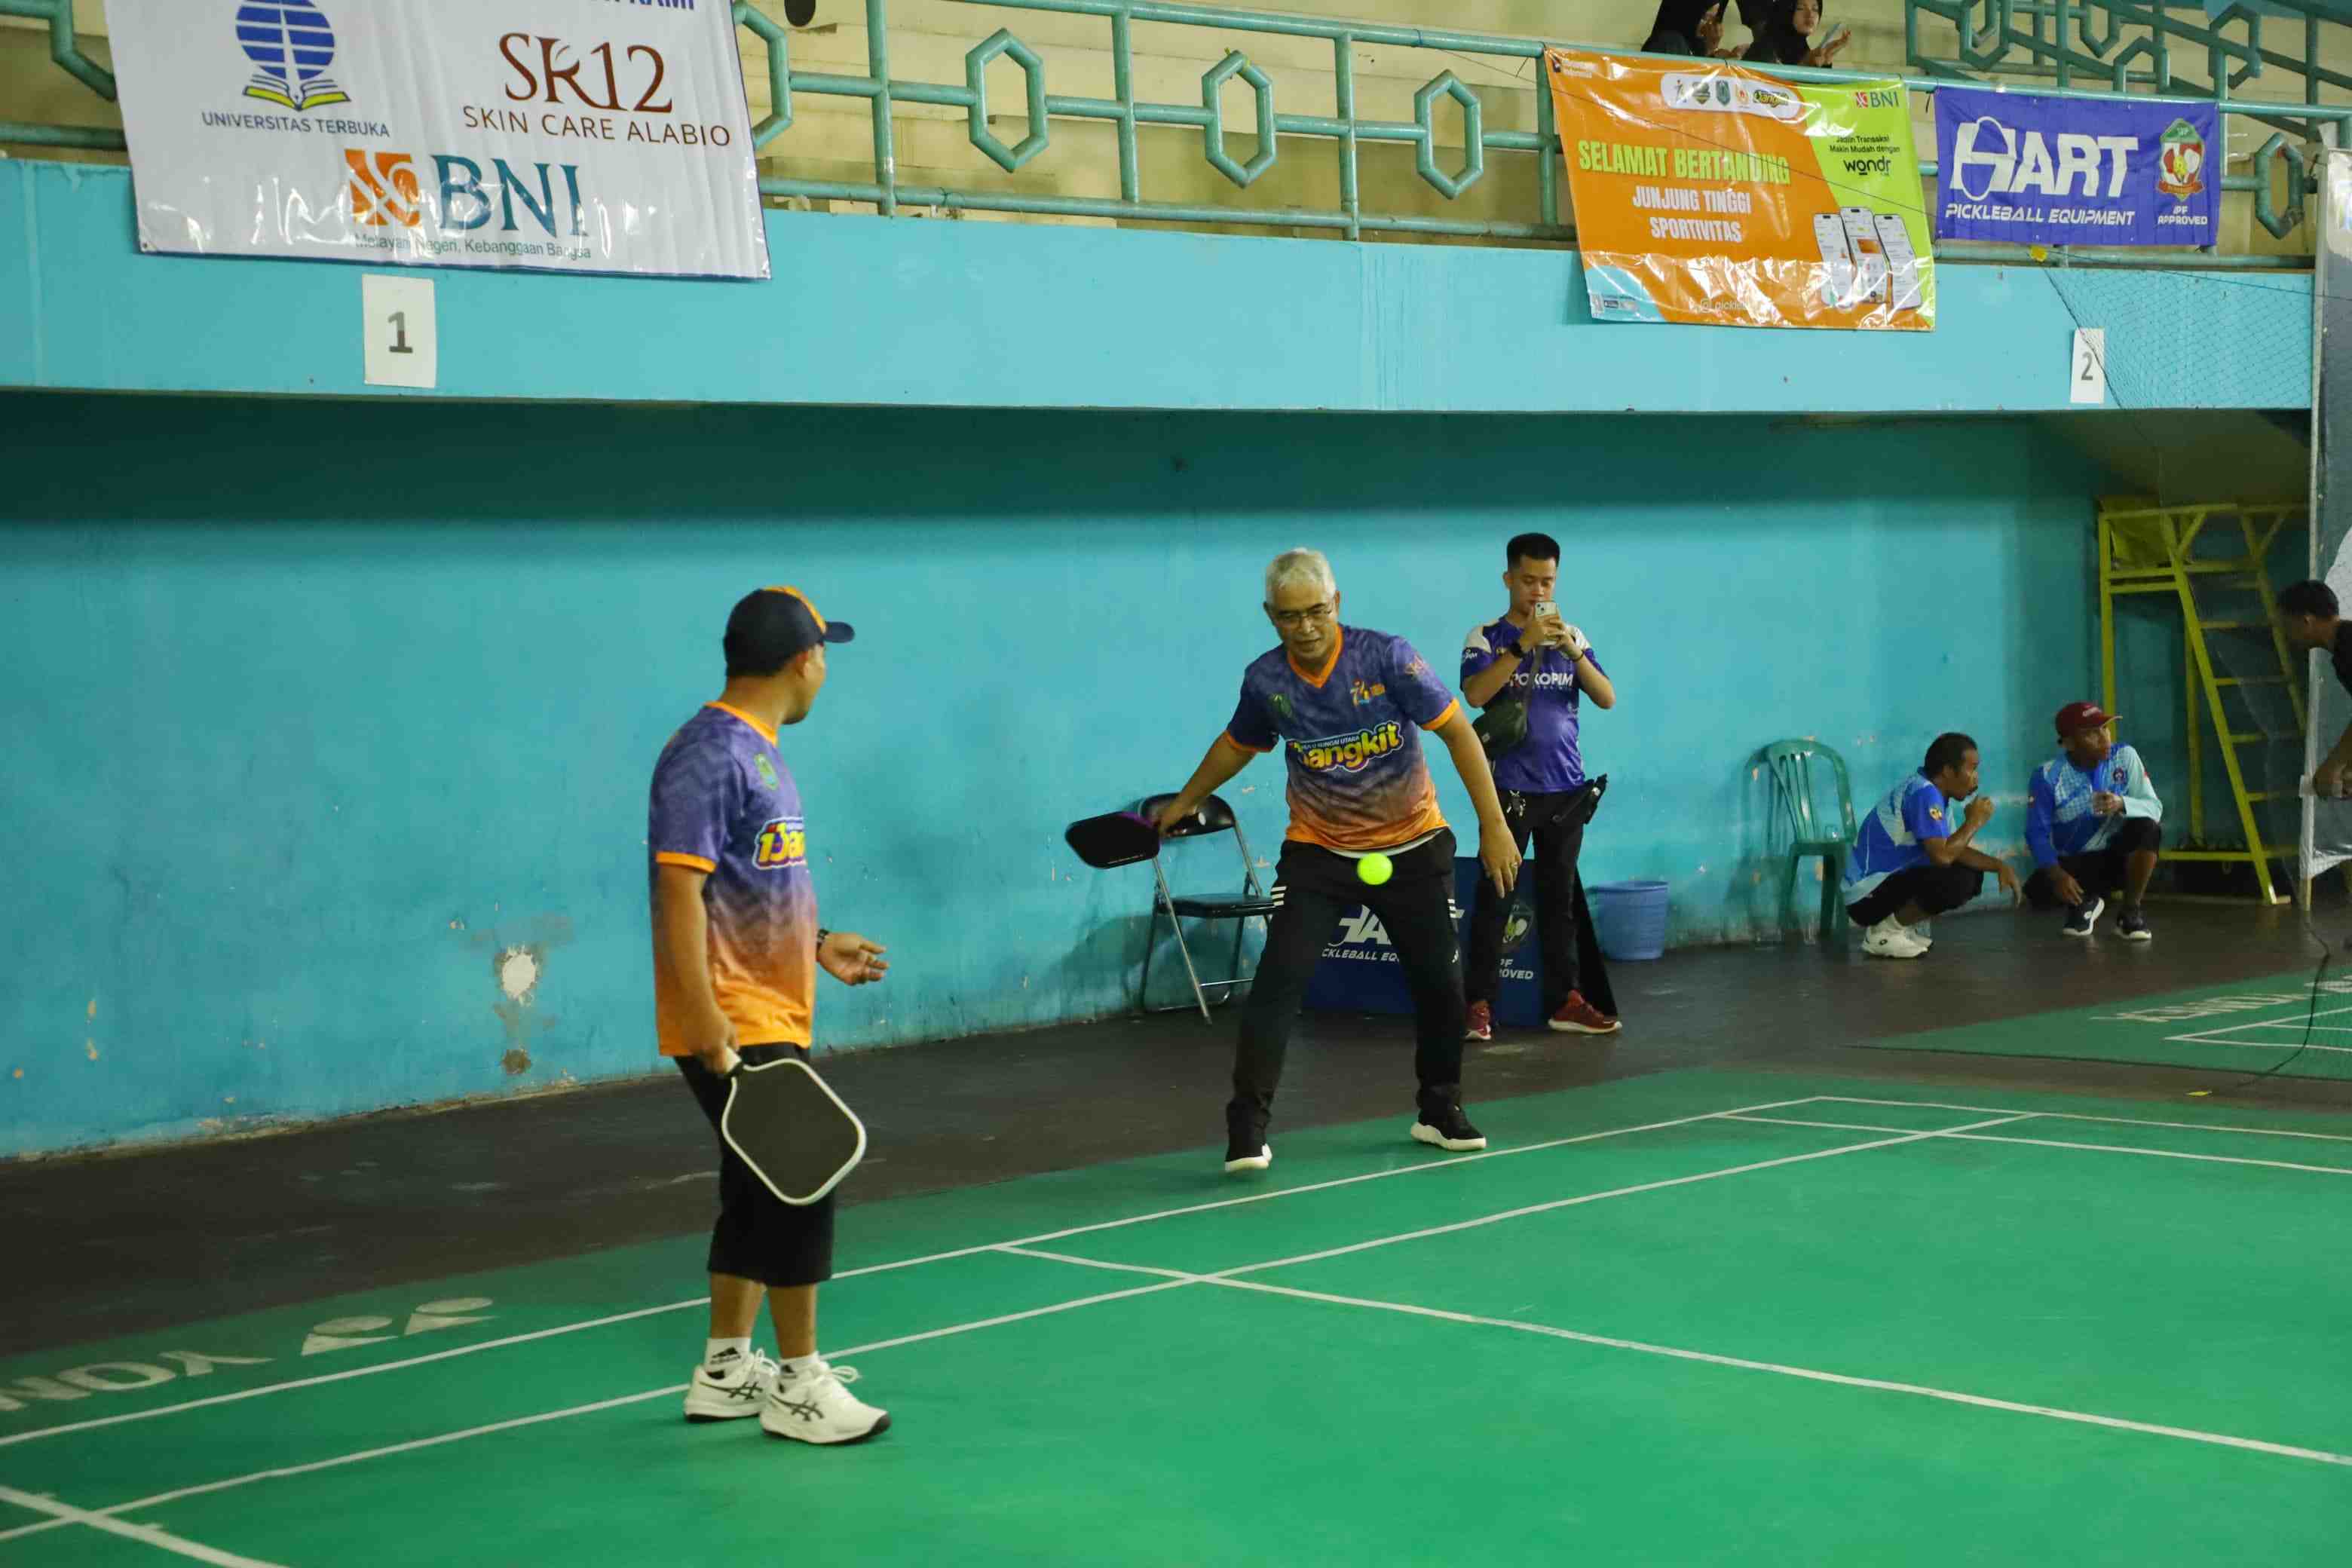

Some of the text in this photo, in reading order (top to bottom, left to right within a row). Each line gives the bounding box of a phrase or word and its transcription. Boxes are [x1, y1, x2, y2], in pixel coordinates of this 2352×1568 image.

[499, 32, 672, 113] SK12
[1870, 91, 1899, 107] BNI
[201, 112, 390, 137] UNIVERSITAS TERBUKA
[464, 106, 730, 146] SKIN CARE ALABIO
[1579, 140, 1790, 185] SELAMAT BERTANDING
[1949, 116, 2139, 201] HART
[430, 155, 589, 237] BNI
[1633, 185, 1751, 214] JUNJUNG TINGGI
[1946, 204, 2135, 225] PICKLEBALL EQUIPMENT
[2158, 216, 2207, 225] APPROVED
[1649, 216, 1742, 243] SPORTIVITAS
[387, 311, 413, 354] 1
[2081, 351, 2093, 381] 2
[1321, 948, 1377, 960] CKLEBALL
